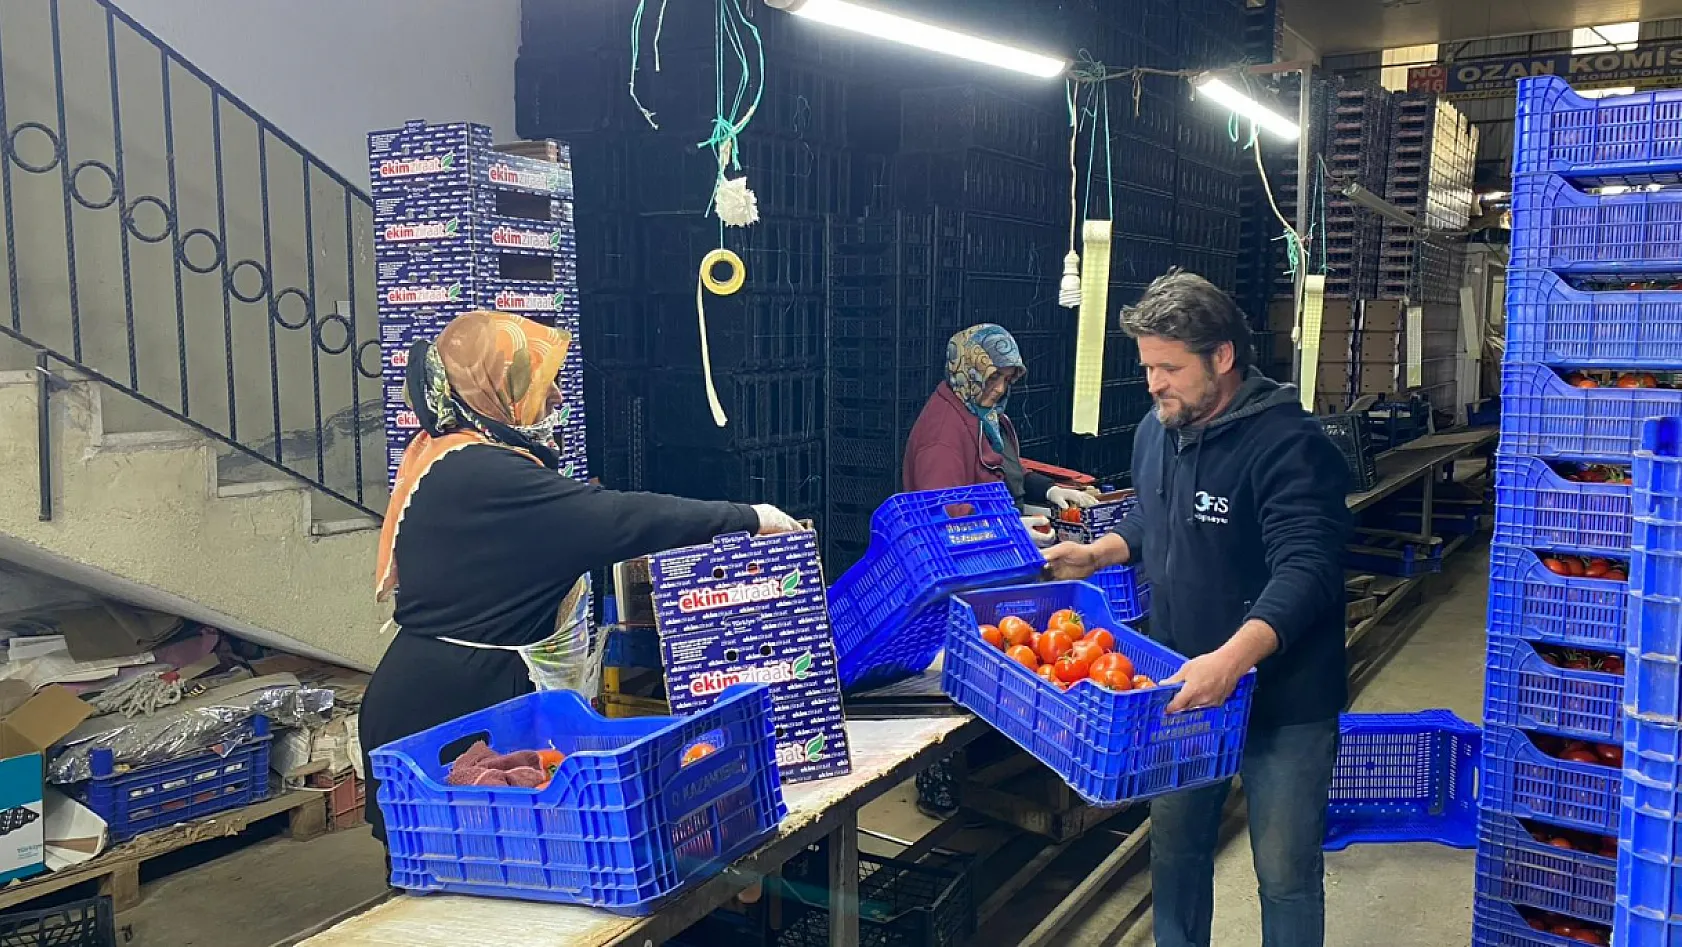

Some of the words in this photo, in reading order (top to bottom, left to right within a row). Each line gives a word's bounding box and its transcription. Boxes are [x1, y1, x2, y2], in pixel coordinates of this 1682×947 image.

[1412, 67, 1442, 79] NO
[1457, 60, 1555, 83] OZAN
[382, 158, 441, 175] ekimziraat
[490, 164, 548, 188] ekimziraat
[386, 224, 445, 240] ekimziraat
[493, 227, 549, 247] ekimziraat
[389, 287, 448, 303] ekimziraat
[496, 290, 552, 309] ekimziraat
[682, 582, 778, 608] ekimziraat
[693, 664, 790, 693] ekimziraat
